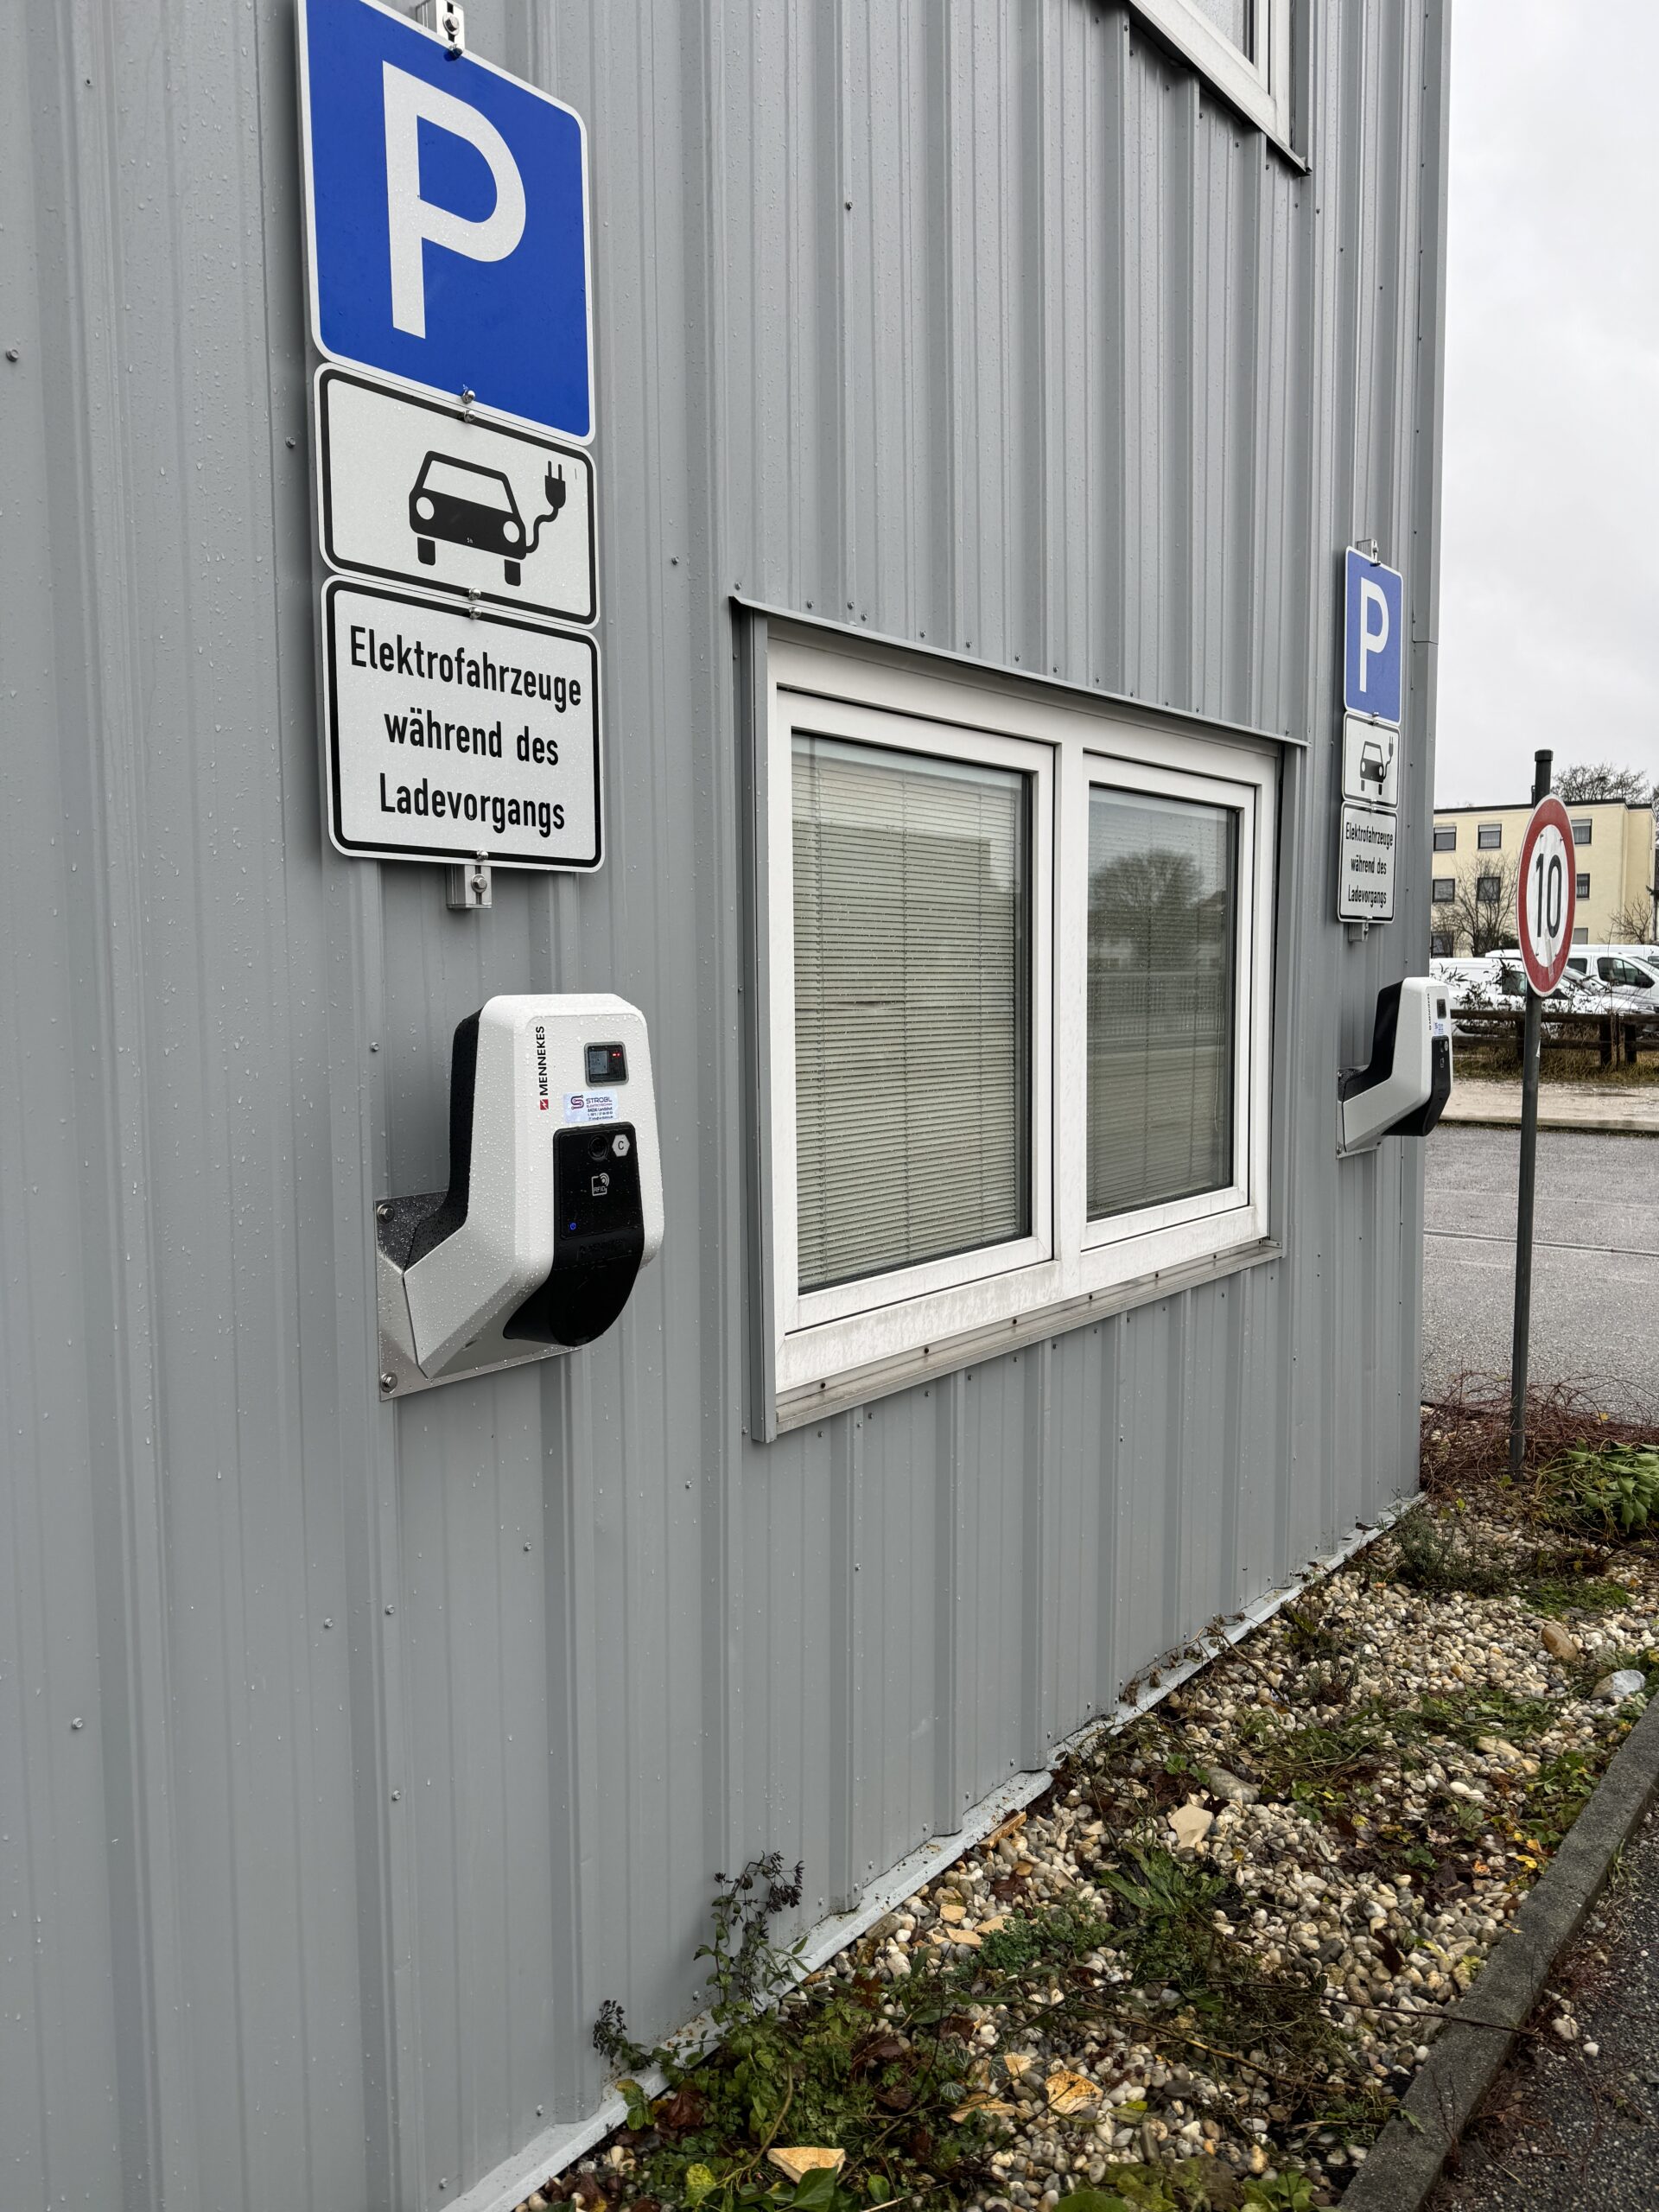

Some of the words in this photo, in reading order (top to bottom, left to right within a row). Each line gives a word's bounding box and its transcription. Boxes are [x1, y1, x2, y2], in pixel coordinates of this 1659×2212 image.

[383, 60, 526, 340] P
[1359, 577, 1389, 693] P
[351, 625, 582, 714] Elektrofahrzeuge
[385, 708, 503, 759] während
[517, 725, 559, 766] des
[380, 772, 566, 838] Ladevorgangs
[1345, 822, 1394, 848] Elektrofahrzeuge
[1348, 885, 1387, 909] Ladevorgangs
[1351, 855, 1376, 874] während
[1376, 858, 1387, 875] des
[1535, 853, 1562, 938] 10
[535, 1026, 549, 1096] MENNEKES
[617, 1140, 625, 1151] C
